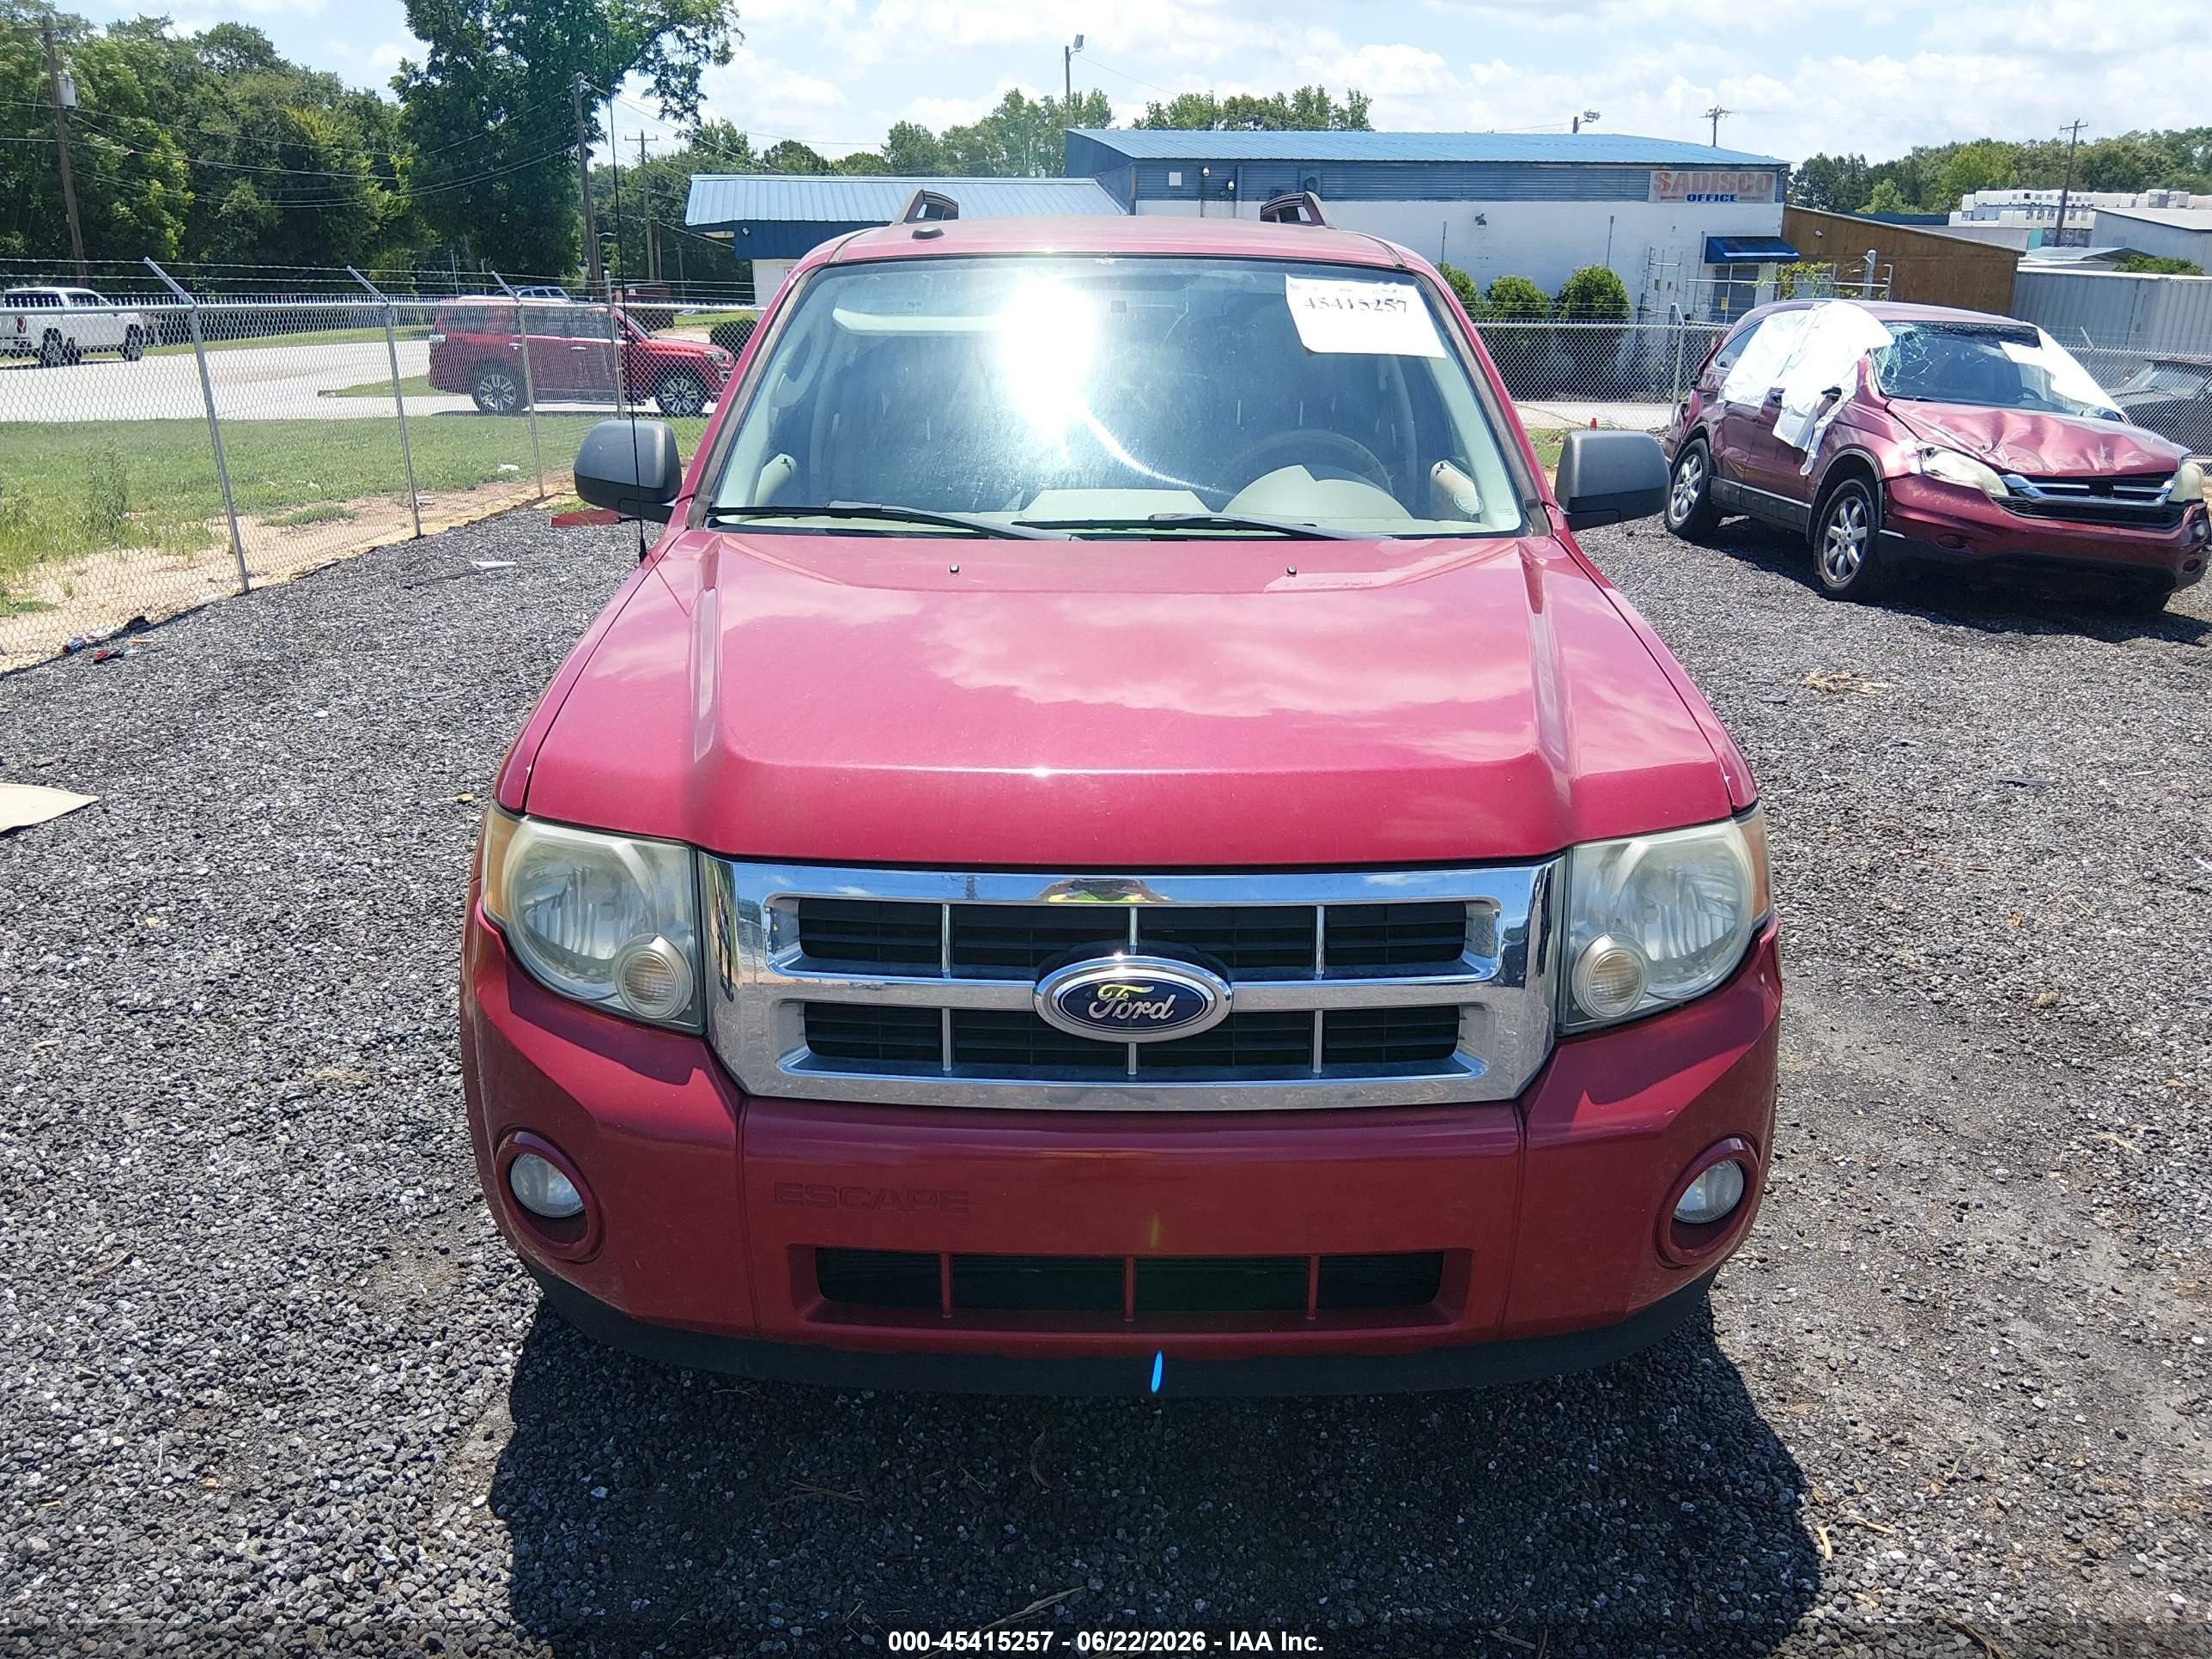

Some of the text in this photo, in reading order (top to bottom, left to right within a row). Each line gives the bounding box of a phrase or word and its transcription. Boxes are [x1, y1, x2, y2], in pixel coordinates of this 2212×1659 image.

[1654, 172, 1772, 191] SADISCO
[1686, 194, 1738, 203] OFFICE
[1304, 296, 1406, 313] 45415257
[1088, 983, 1176, 1019] Ford
[775, 1182, 969, 1212] ESCAPE
